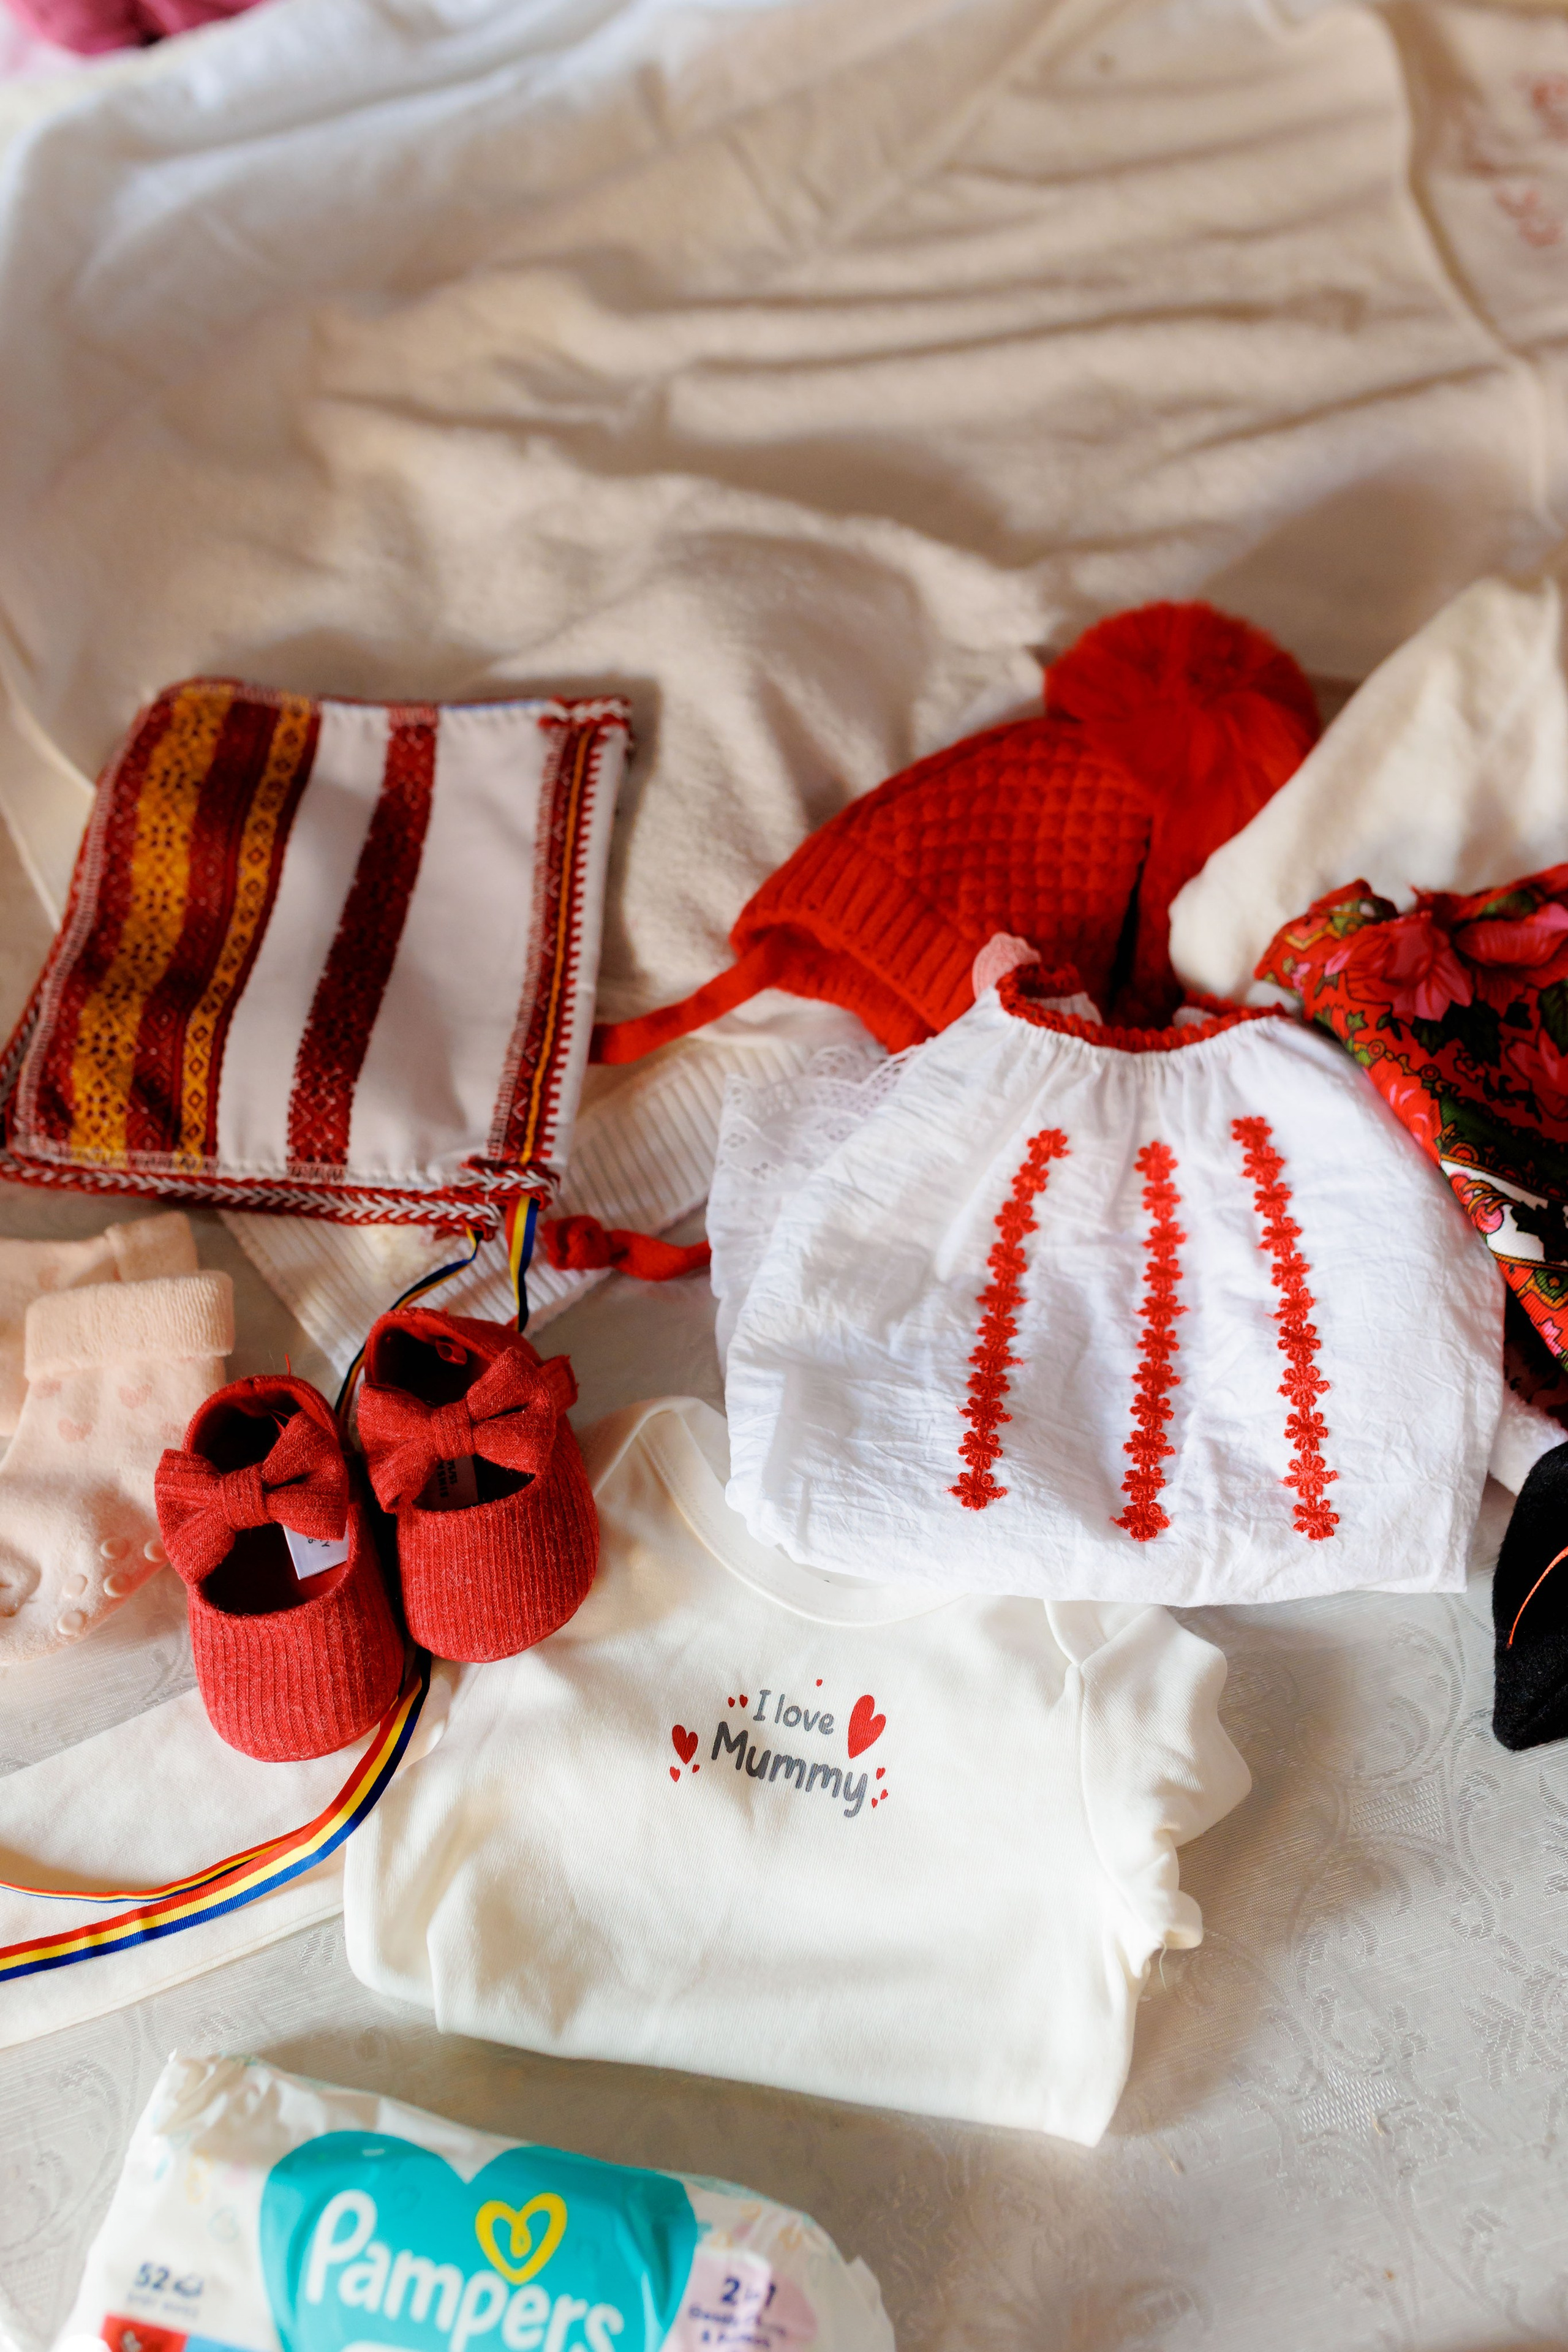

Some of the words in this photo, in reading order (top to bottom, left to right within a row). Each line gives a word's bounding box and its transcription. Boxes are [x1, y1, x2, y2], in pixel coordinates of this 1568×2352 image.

[753, 1689, 772, 1721] I
[774, 1693, 834, 1735] love
[710, 1721, 868, 1818] Mummy
[134, 2261, 171, 2291] 52
[307, 2188, 625, 2352] Pampers
